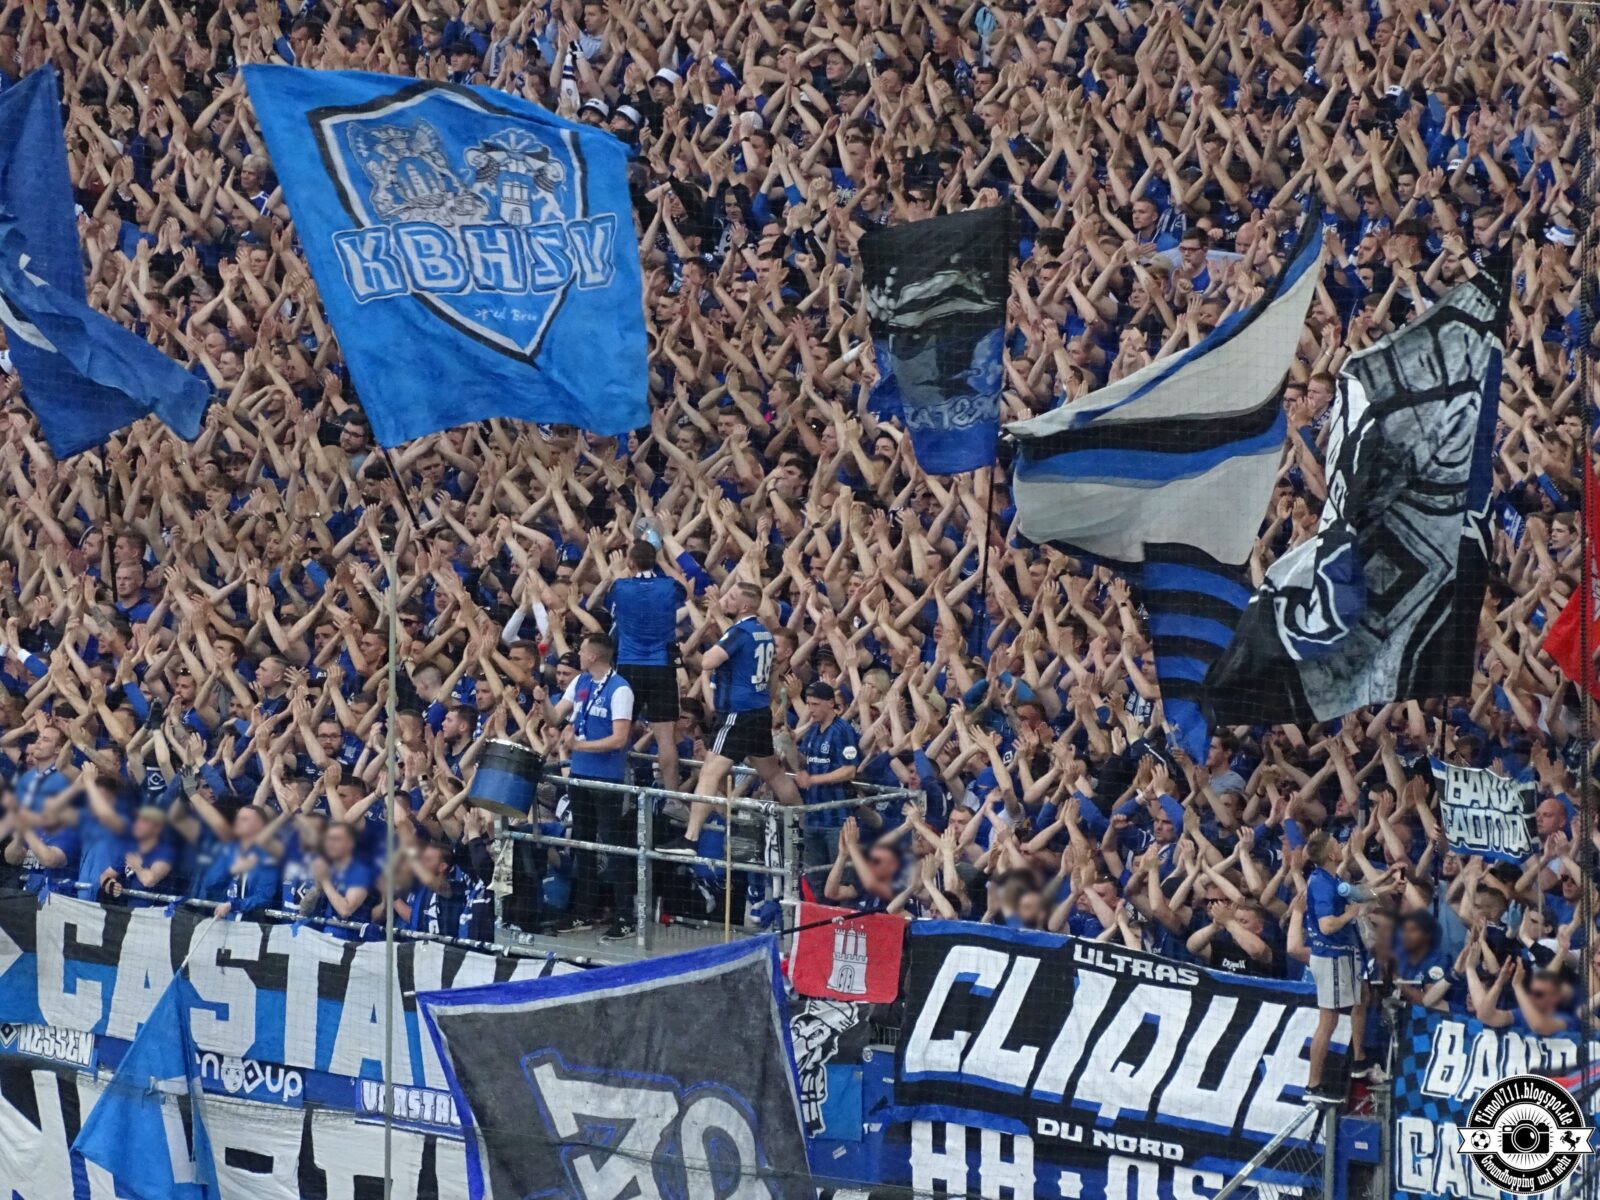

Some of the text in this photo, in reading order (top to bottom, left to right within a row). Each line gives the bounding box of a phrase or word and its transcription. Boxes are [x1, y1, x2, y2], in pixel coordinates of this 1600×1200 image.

[332, 213, 617, 304] KBHSV
[1074, 945, 1199, 986] ULTRAS
[19, 1024, 94, 1067] HESSEN
[905, 945, 1352, 1147] CLIQUE
[1037, 1117, 1185, 1161] DU NORD
